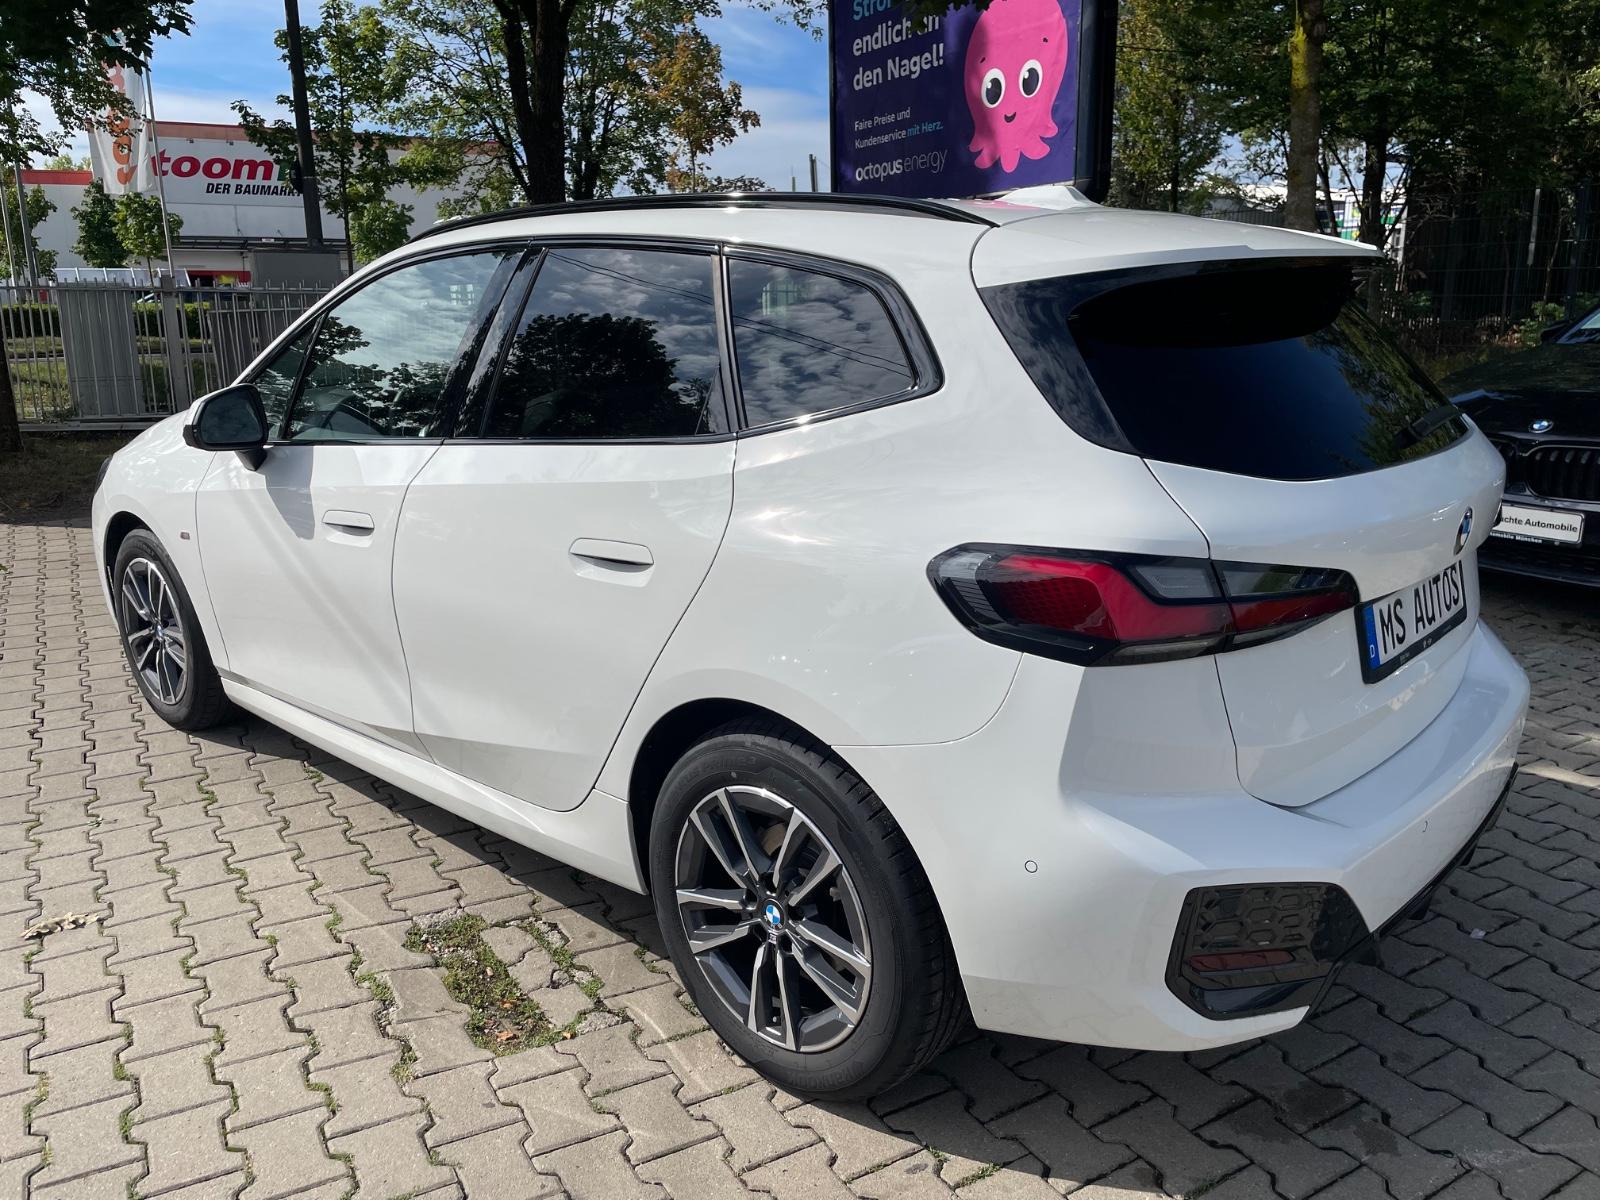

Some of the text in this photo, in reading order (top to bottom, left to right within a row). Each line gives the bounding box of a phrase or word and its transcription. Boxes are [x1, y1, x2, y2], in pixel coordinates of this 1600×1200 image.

[852, 17, 912, 56] endlich
[853, 42, 944, 91] den Nagel!
[854, 106, 911, 131] Faire Preise und
[855, 129, 907, 149] Kundenservice
[907, 124, 921, 137] mit
[150, 148, 275, 181] toom
[206, 182, 231, 195] DER
[1524, 518, 1579, 533] Automobile
[1378, 564, 1460, 655] MS AUTOS
[1369, 644, 1376, 658] D
